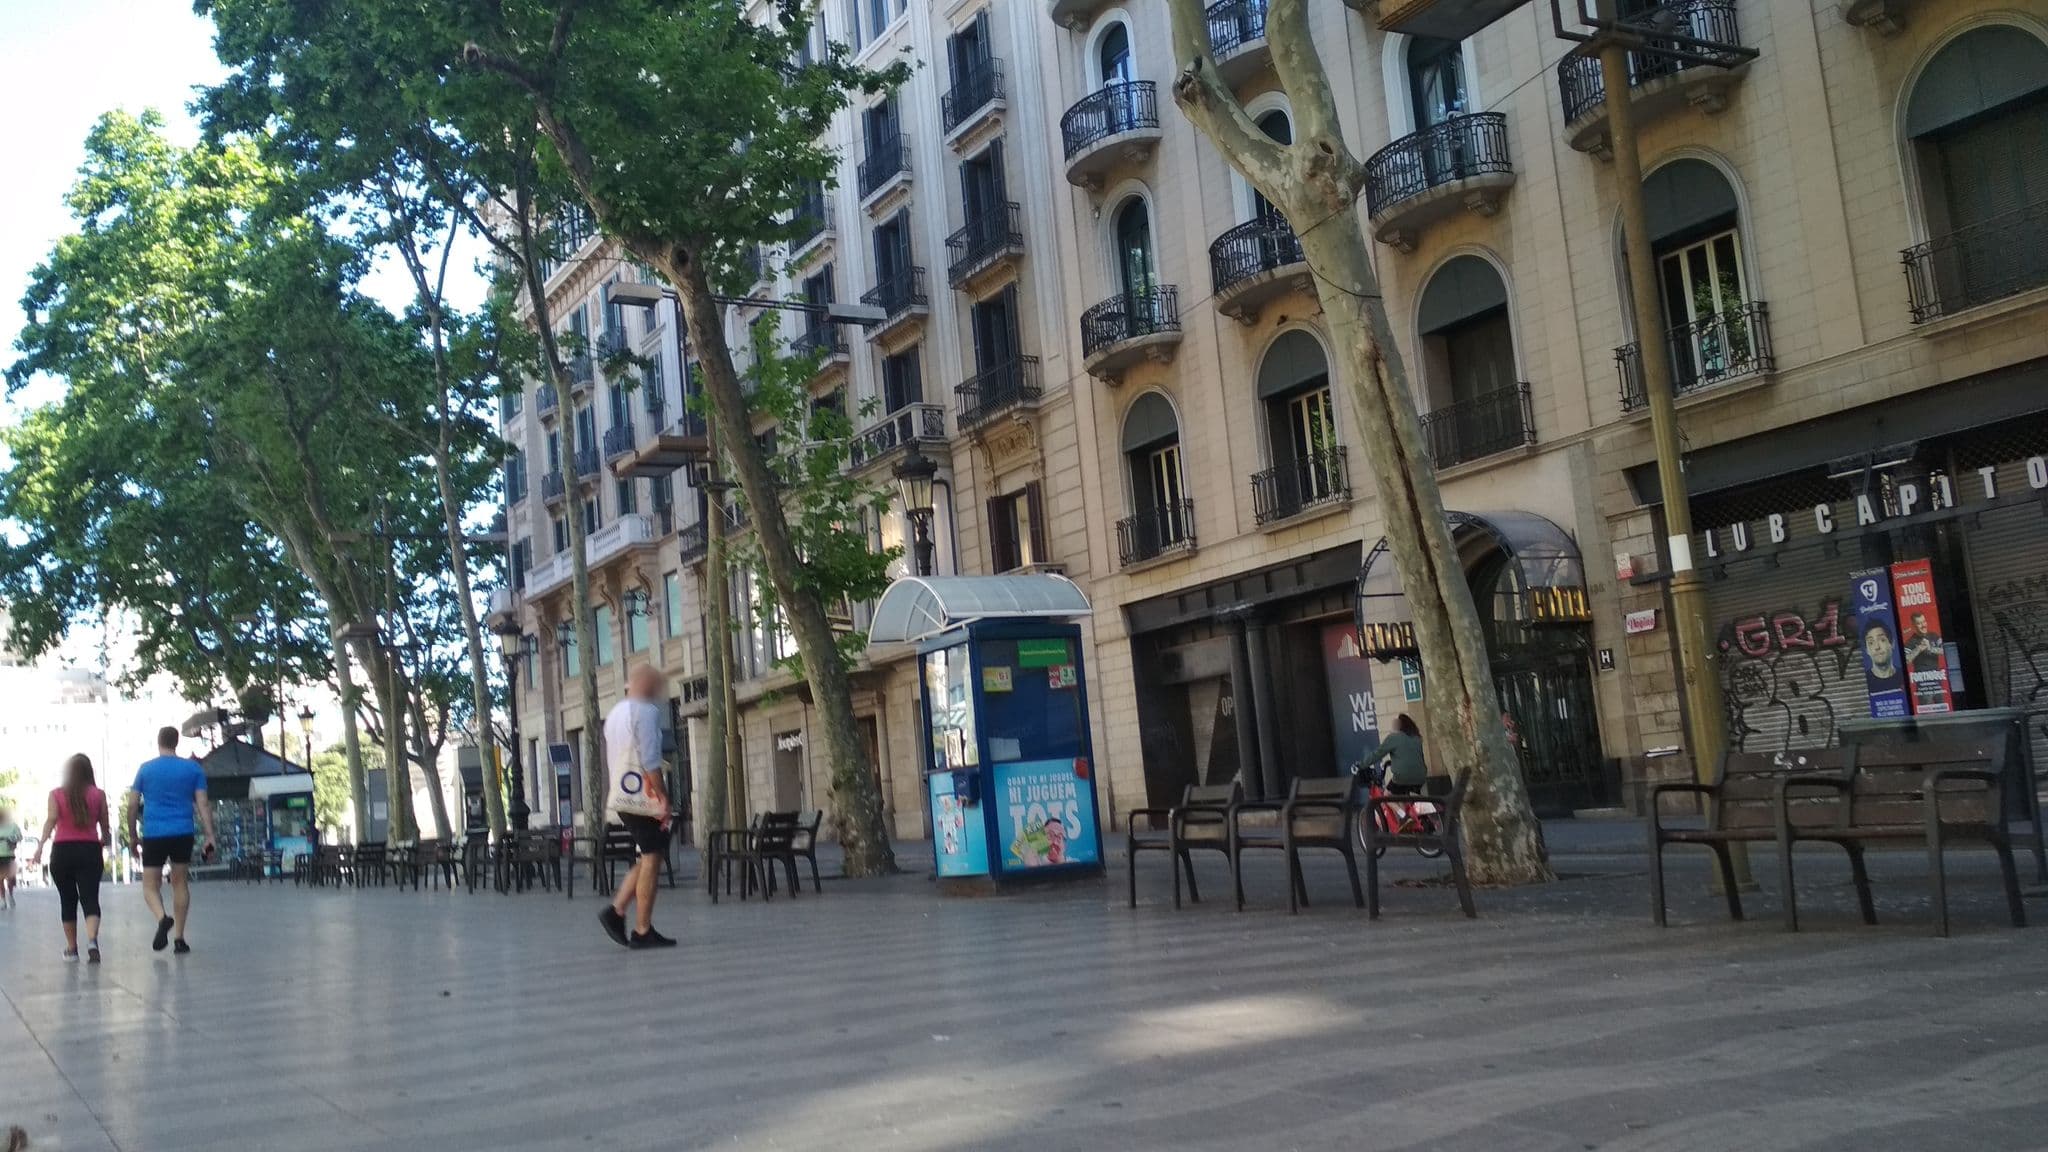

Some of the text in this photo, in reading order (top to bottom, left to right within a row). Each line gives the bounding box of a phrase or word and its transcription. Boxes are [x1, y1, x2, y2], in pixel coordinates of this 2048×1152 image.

[1705, 512, 1785, 558] LUB
[1902, 581, 1926, 596] TONI
[1901, 592, 1931, 607] MOOG
[1601, 650, 1611, 664] H
[1407, 680, 1417, 694] H
[1026, 782, 1077, 803] JUGUEM
[1009, 799, 1082, 841] TOTS
